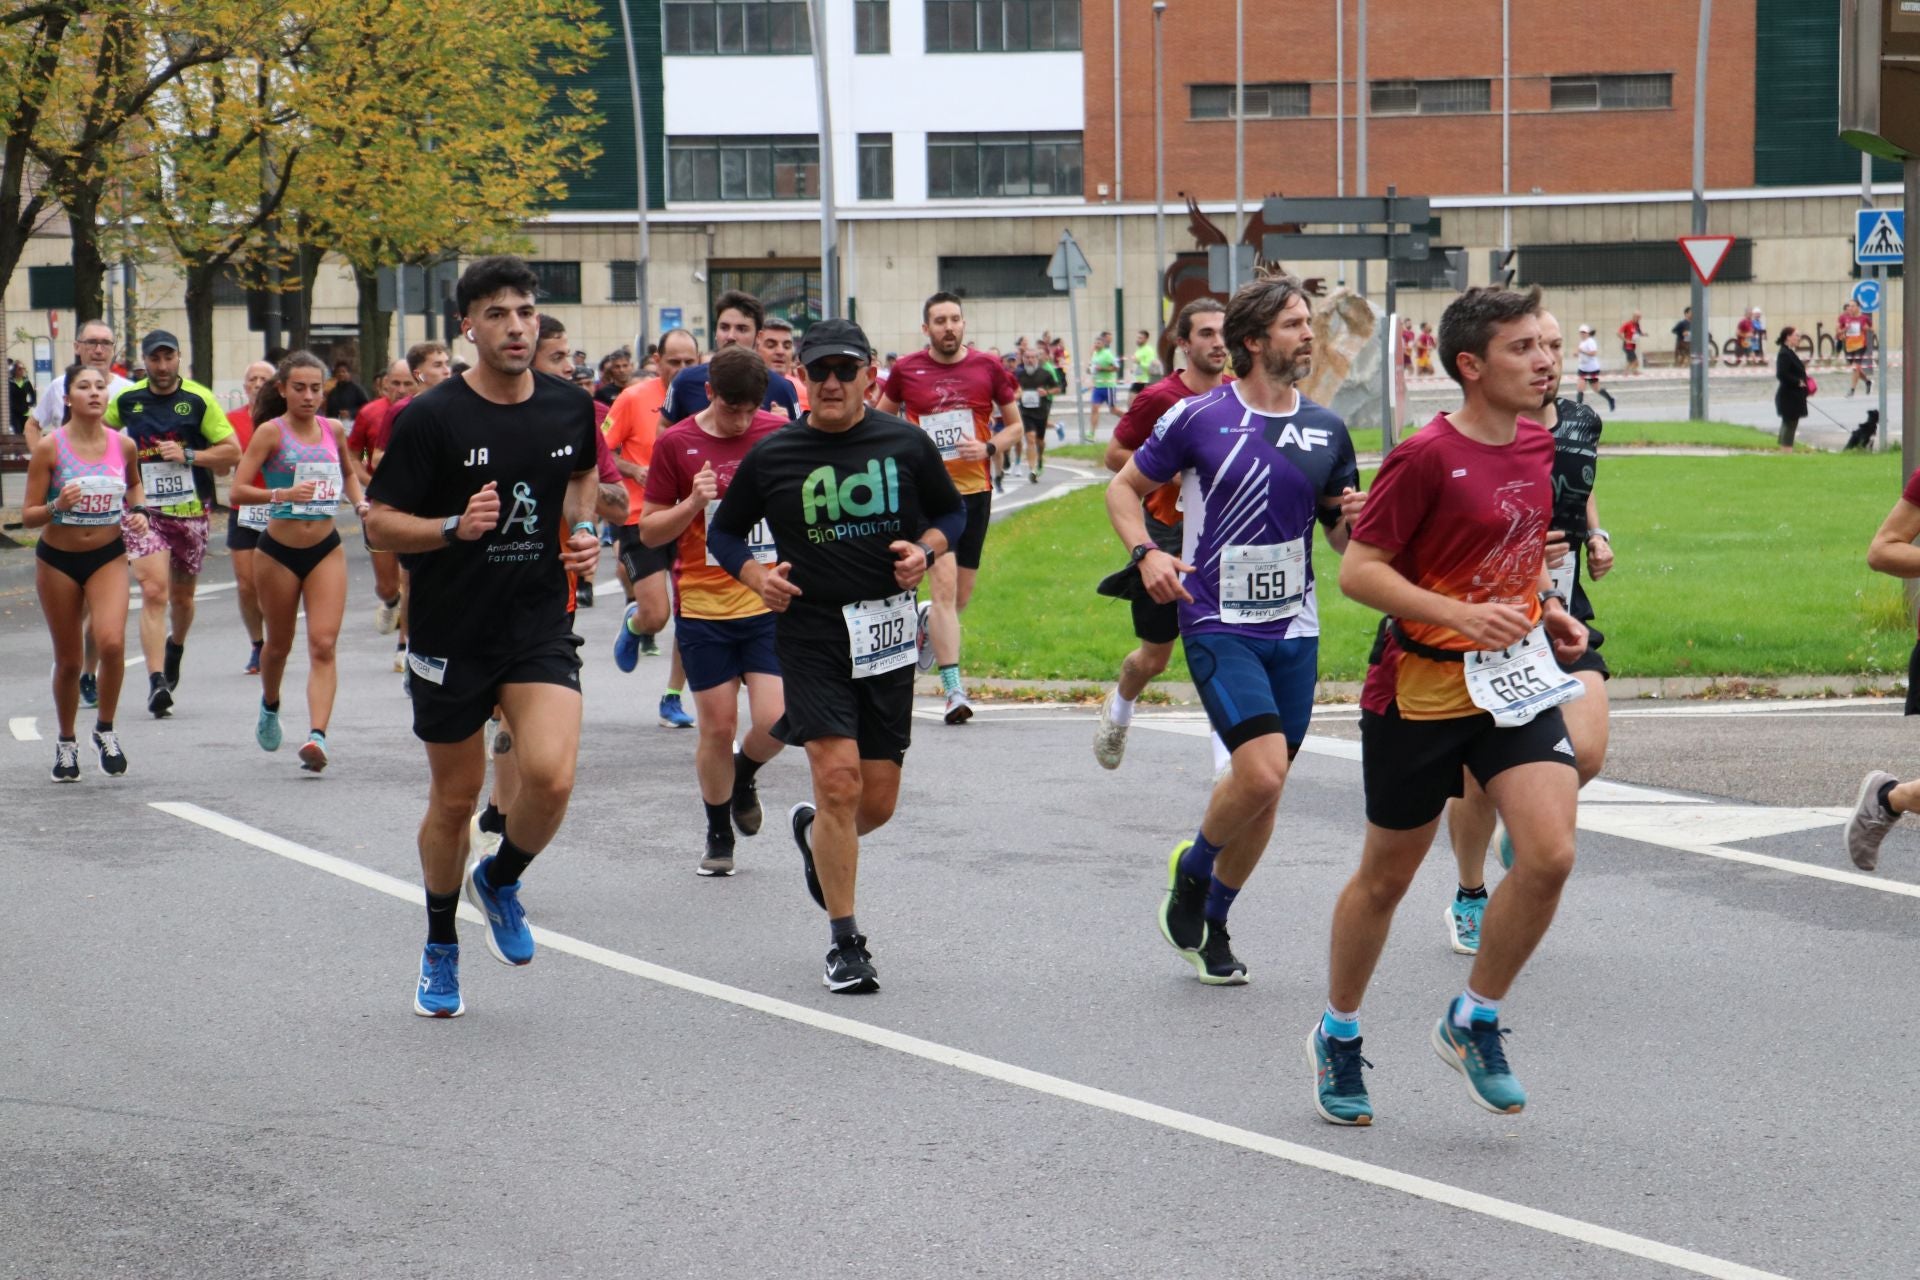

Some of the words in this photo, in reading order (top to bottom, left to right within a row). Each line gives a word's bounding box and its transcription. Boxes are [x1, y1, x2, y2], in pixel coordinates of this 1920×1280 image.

[935, 427, 962, 447] 637
[1276, 423, 1328, 451] AF
[464, 447, 489, 467] JA
[155, 476, 184, 493] 639
[315, 480, 335, 499] 34
[802, 457, 899, 524] Adl
[80, 494, 113, 513] 939
[807, 520, 900, 543] BioPharma
[1247, 571, 1285, 600] 159
[869, 618, 904, 652] 303
[1489, 665, 1552, 703] 665
